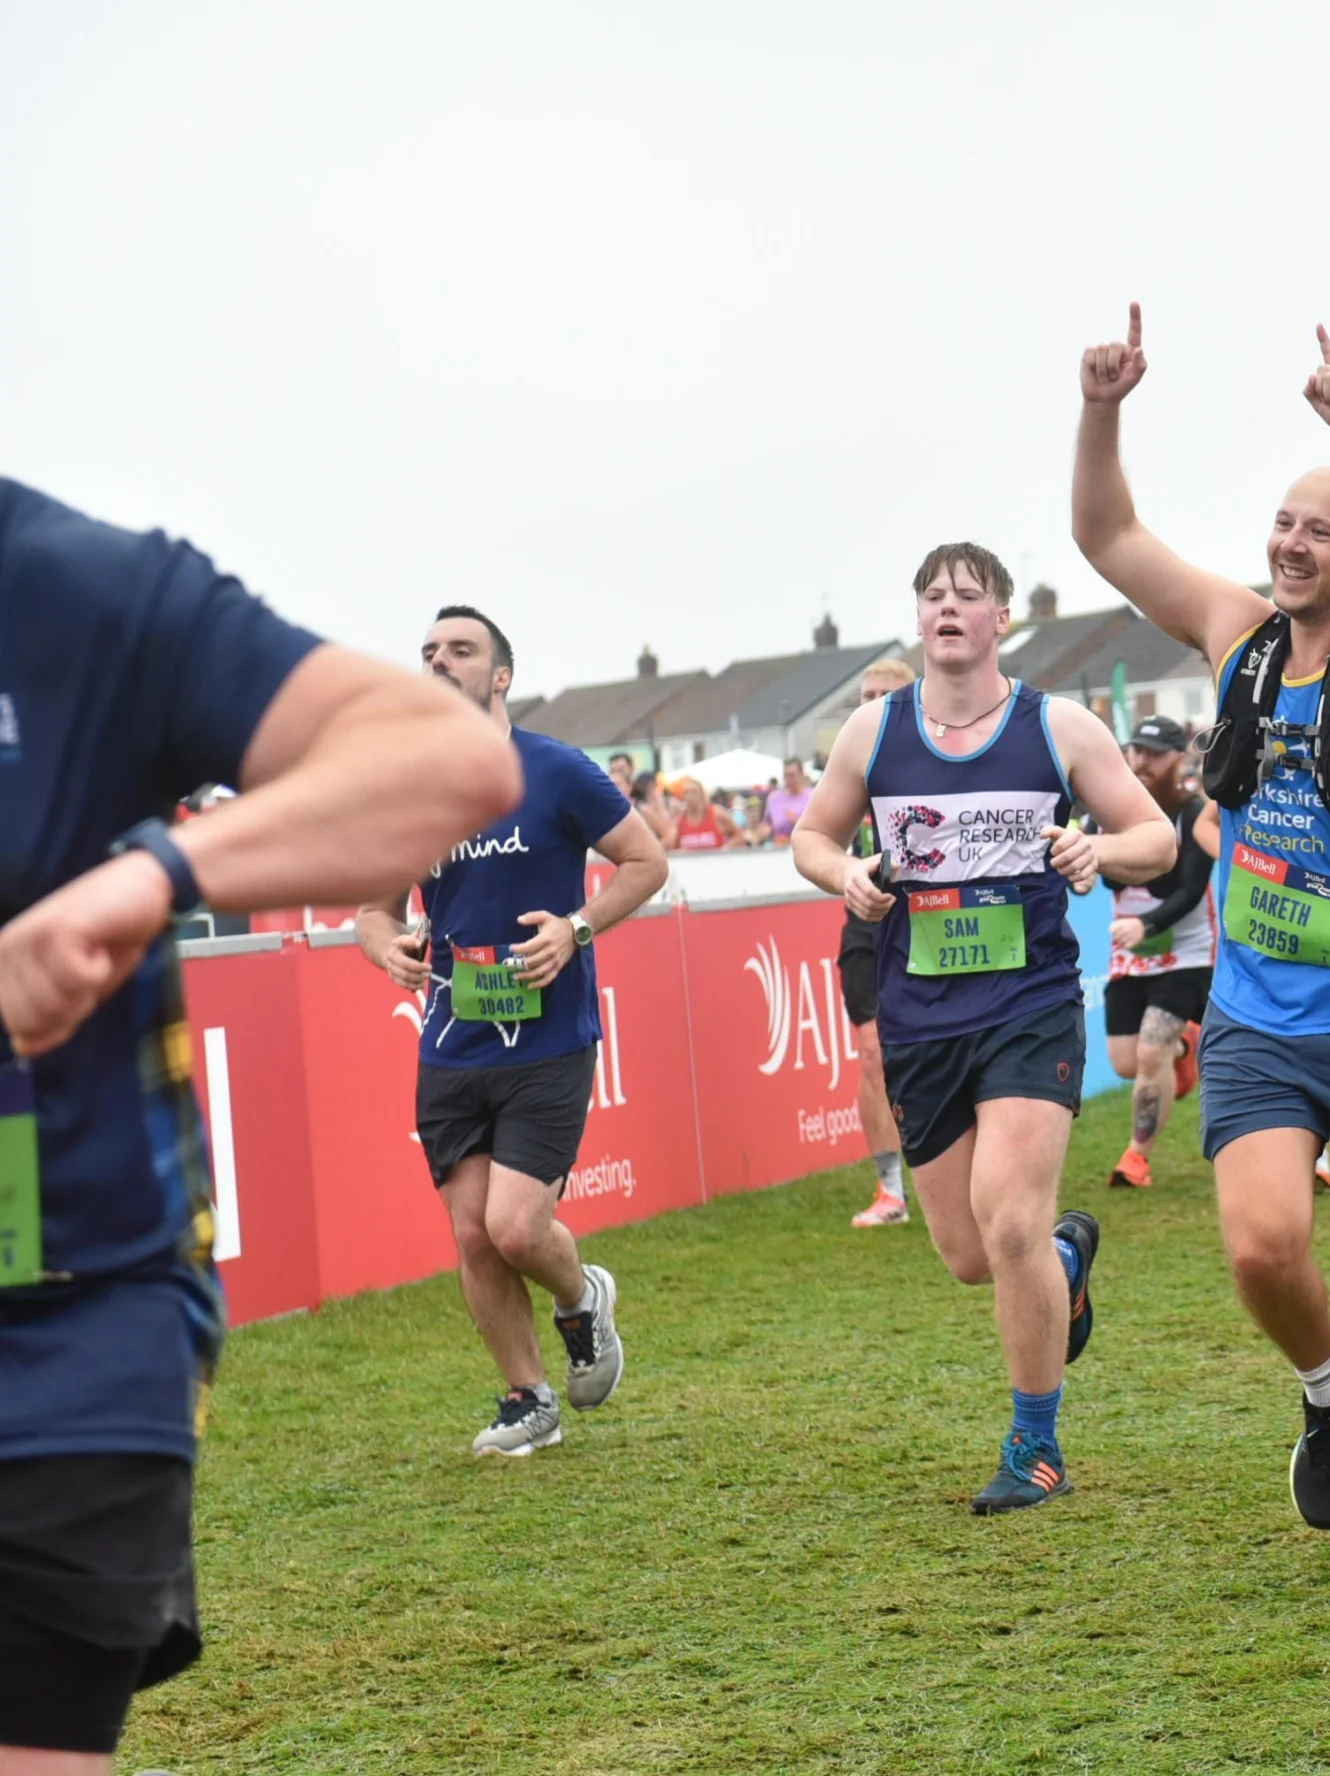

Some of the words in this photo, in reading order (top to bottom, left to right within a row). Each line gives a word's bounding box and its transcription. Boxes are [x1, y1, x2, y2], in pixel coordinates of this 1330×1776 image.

[1251, 784, 1324, 807] rkshire
[958, 809, 1035, 826] CANCER
[1248, 804, 1314, 829] Cancer
[451, 825, 530, 863] mind
[958, 826, 1042, 844] RESEARCH
[958, 847, 983, 862] UK
[1249, 857, 1277, 875] AJBell
[923, 895, 950, 907] AJBell
[1250, 886, 1312, 927] GARETH
[944, 916, 979, 939] SAM
[1248, 919, 1299, 955] 23859
[939, 944, 990, 968] 27171
[478, 996, 525, 1015] 30482
[798, 1105, 825, 1144] Feel
